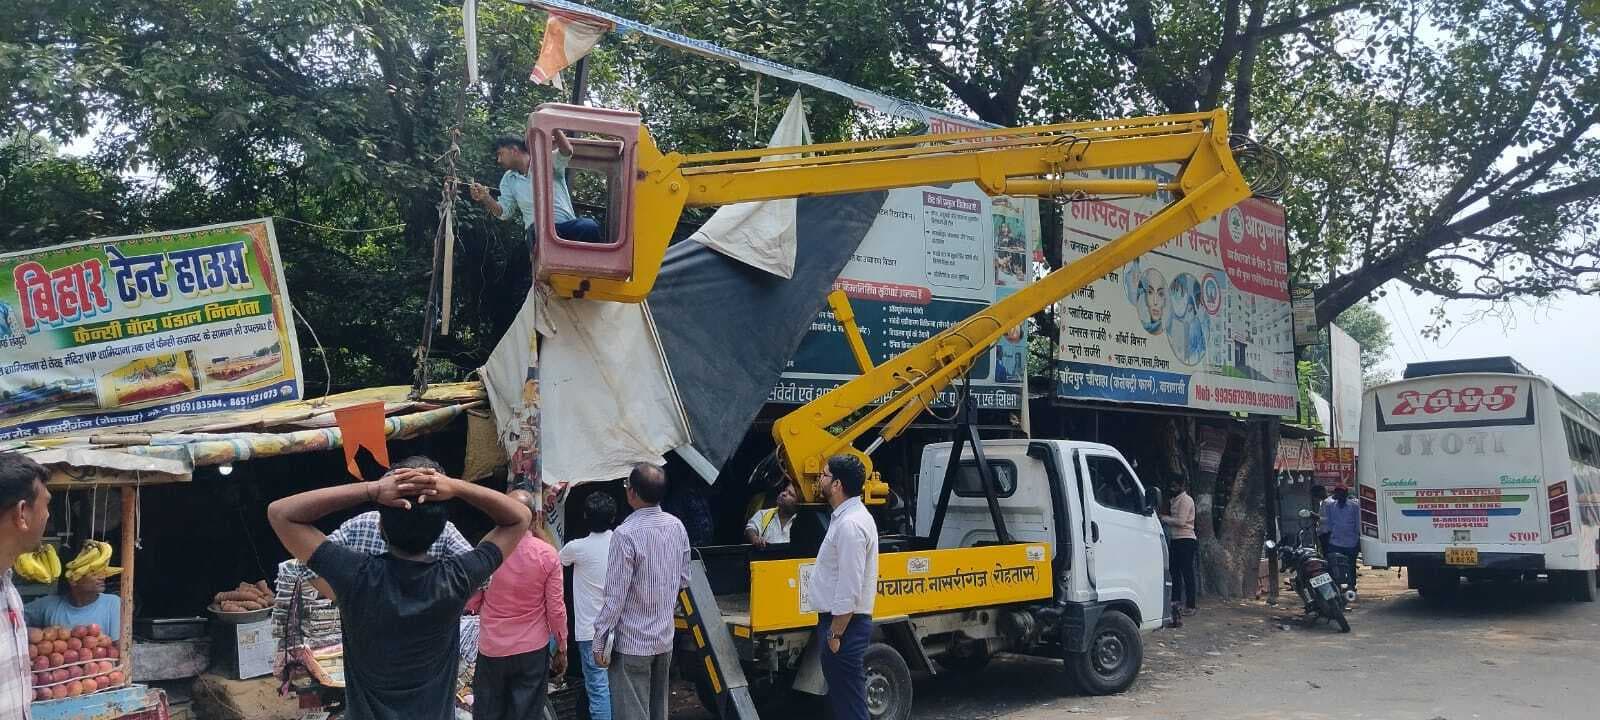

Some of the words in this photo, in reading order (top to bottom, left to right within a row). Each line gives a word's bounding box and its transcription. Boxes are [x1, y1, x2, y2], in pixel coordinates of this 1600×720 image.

[1069, 240, 1089, 254] जनरल
[1266, 258, 1272, 272] 5
[13, 258, 109, 331] बिहार
[104, 245, 169, 303] टेन्ट
[167, 241, 251, 295] हाउस
[161, 310, 202, 329] पंडाल
[205, 300, 261, 321] निर्माता
[1068, 305, 1093, 320] प्लास्टिक
[1095, 310, 1111, 323] सर्जरी
[1068, 326, 1088, 340] जनरल
[1089, 328, 1107, 341] सर्जरी
[85, 352, 97, 362] VIP
[99, 345, 130, 359] शामियाना
[211, 328, 233, 339] सामान
[234, 326, 243, 335] भी
[1068, 343, 1082, 360] न्यूरो
[1083, 344, 1101, 358] सर्जरी
[798, 384, 814, 401] एवं
[1159, 379, 1186, 395] वाराणसी
[996, 389, 1017, 407] शिक्षा
[38, 419, 93, 434] नासरीगंज
[1415, 489, 1444, 497] JYOTI
[1451, 487, 1502, 496] TRAVELS
[1391, 532, 1418, 542] STOP
[1509, 532, 1539, 542] STOP
[928, 567, 988, 593] नासरीगंज
[990, 562, 1040, 585] (रोहतास)
